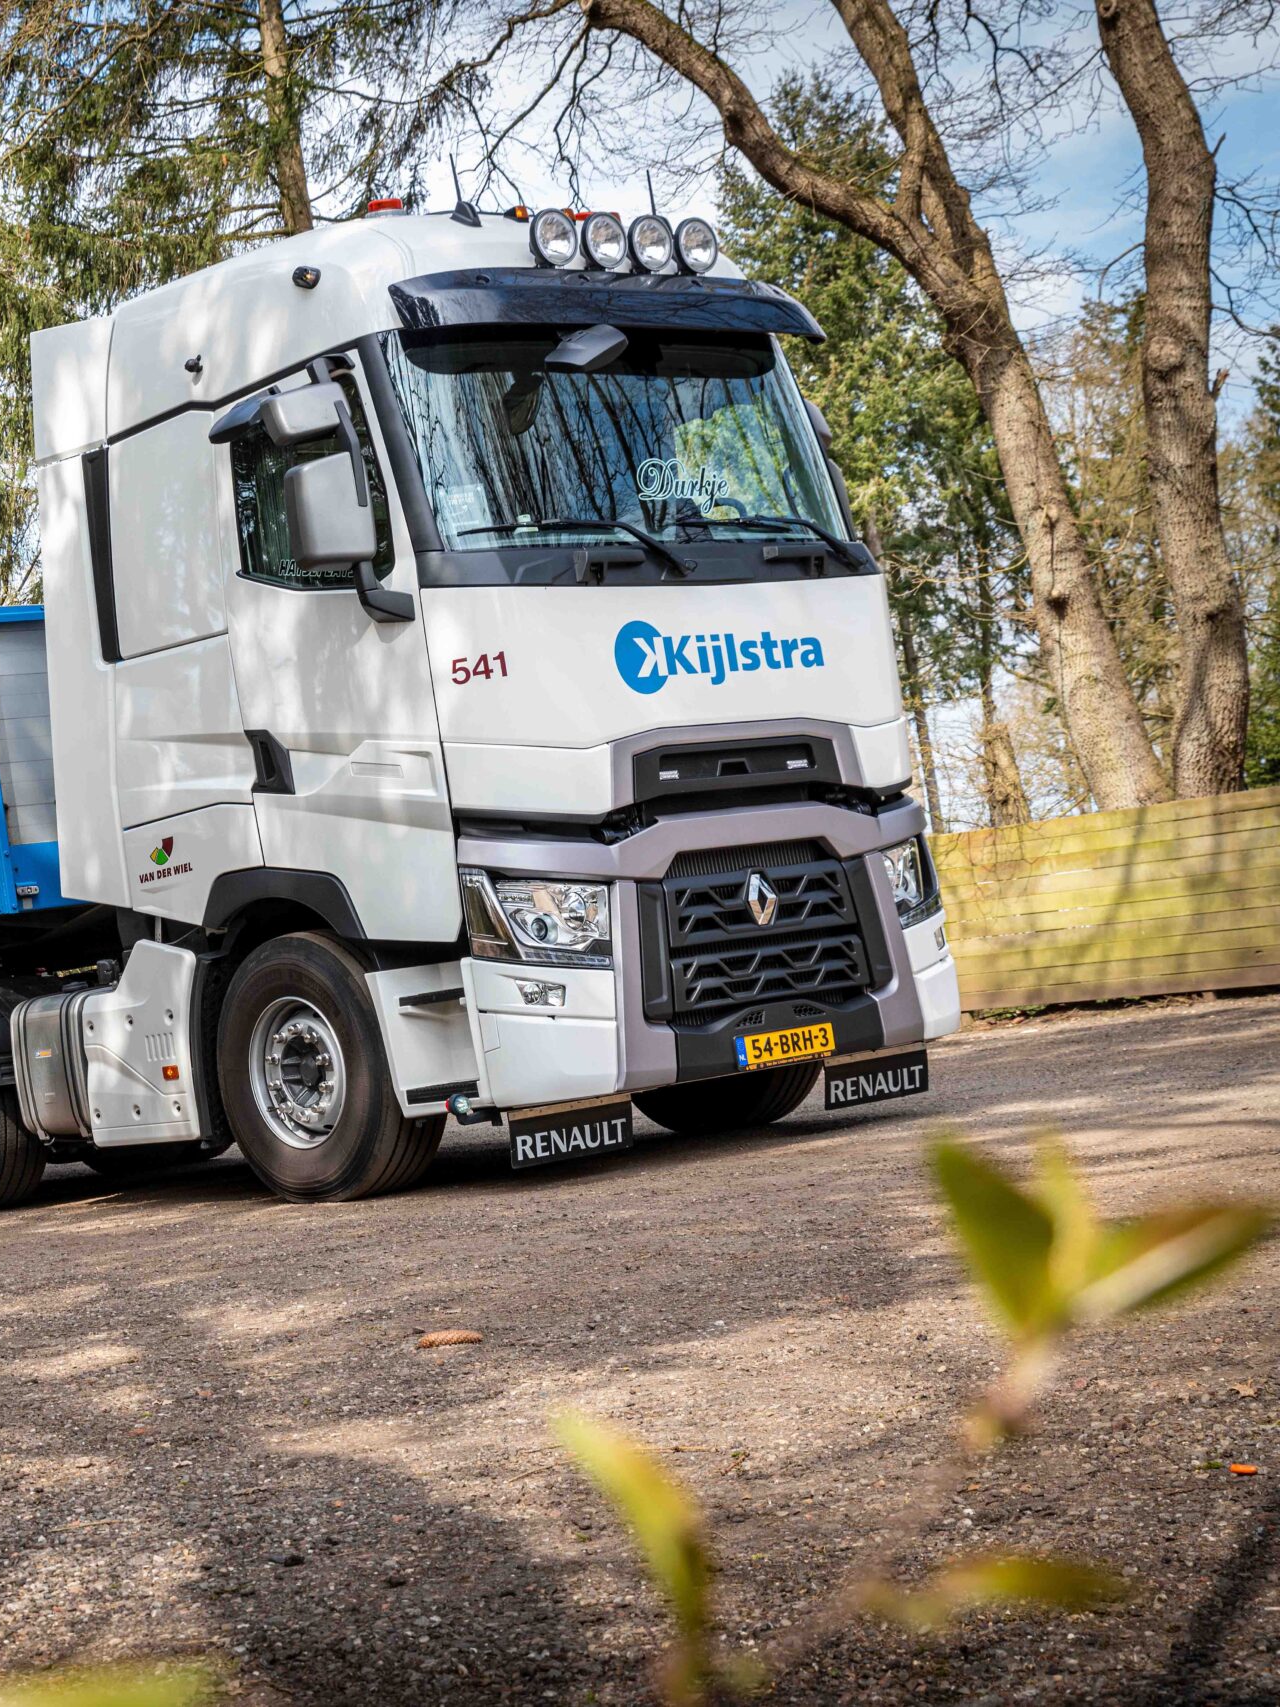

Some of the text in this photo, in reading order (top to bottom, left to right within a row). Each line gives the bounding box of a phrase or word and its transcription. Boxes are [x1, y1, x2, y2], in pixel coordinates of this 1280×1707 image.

[637, 458, 729, 514] Durkje
[451, 650, 509, 686] 541
[662, 631, 825, 685] Kijlstra
[139, 861, 193, 884] VAN DER WIEL
[751, 1027, 829, 1059] 54-BRH-3
[830, 1065, 924, 1103] RENAULT
[516, 1118, 626, 1161] RENAULT
